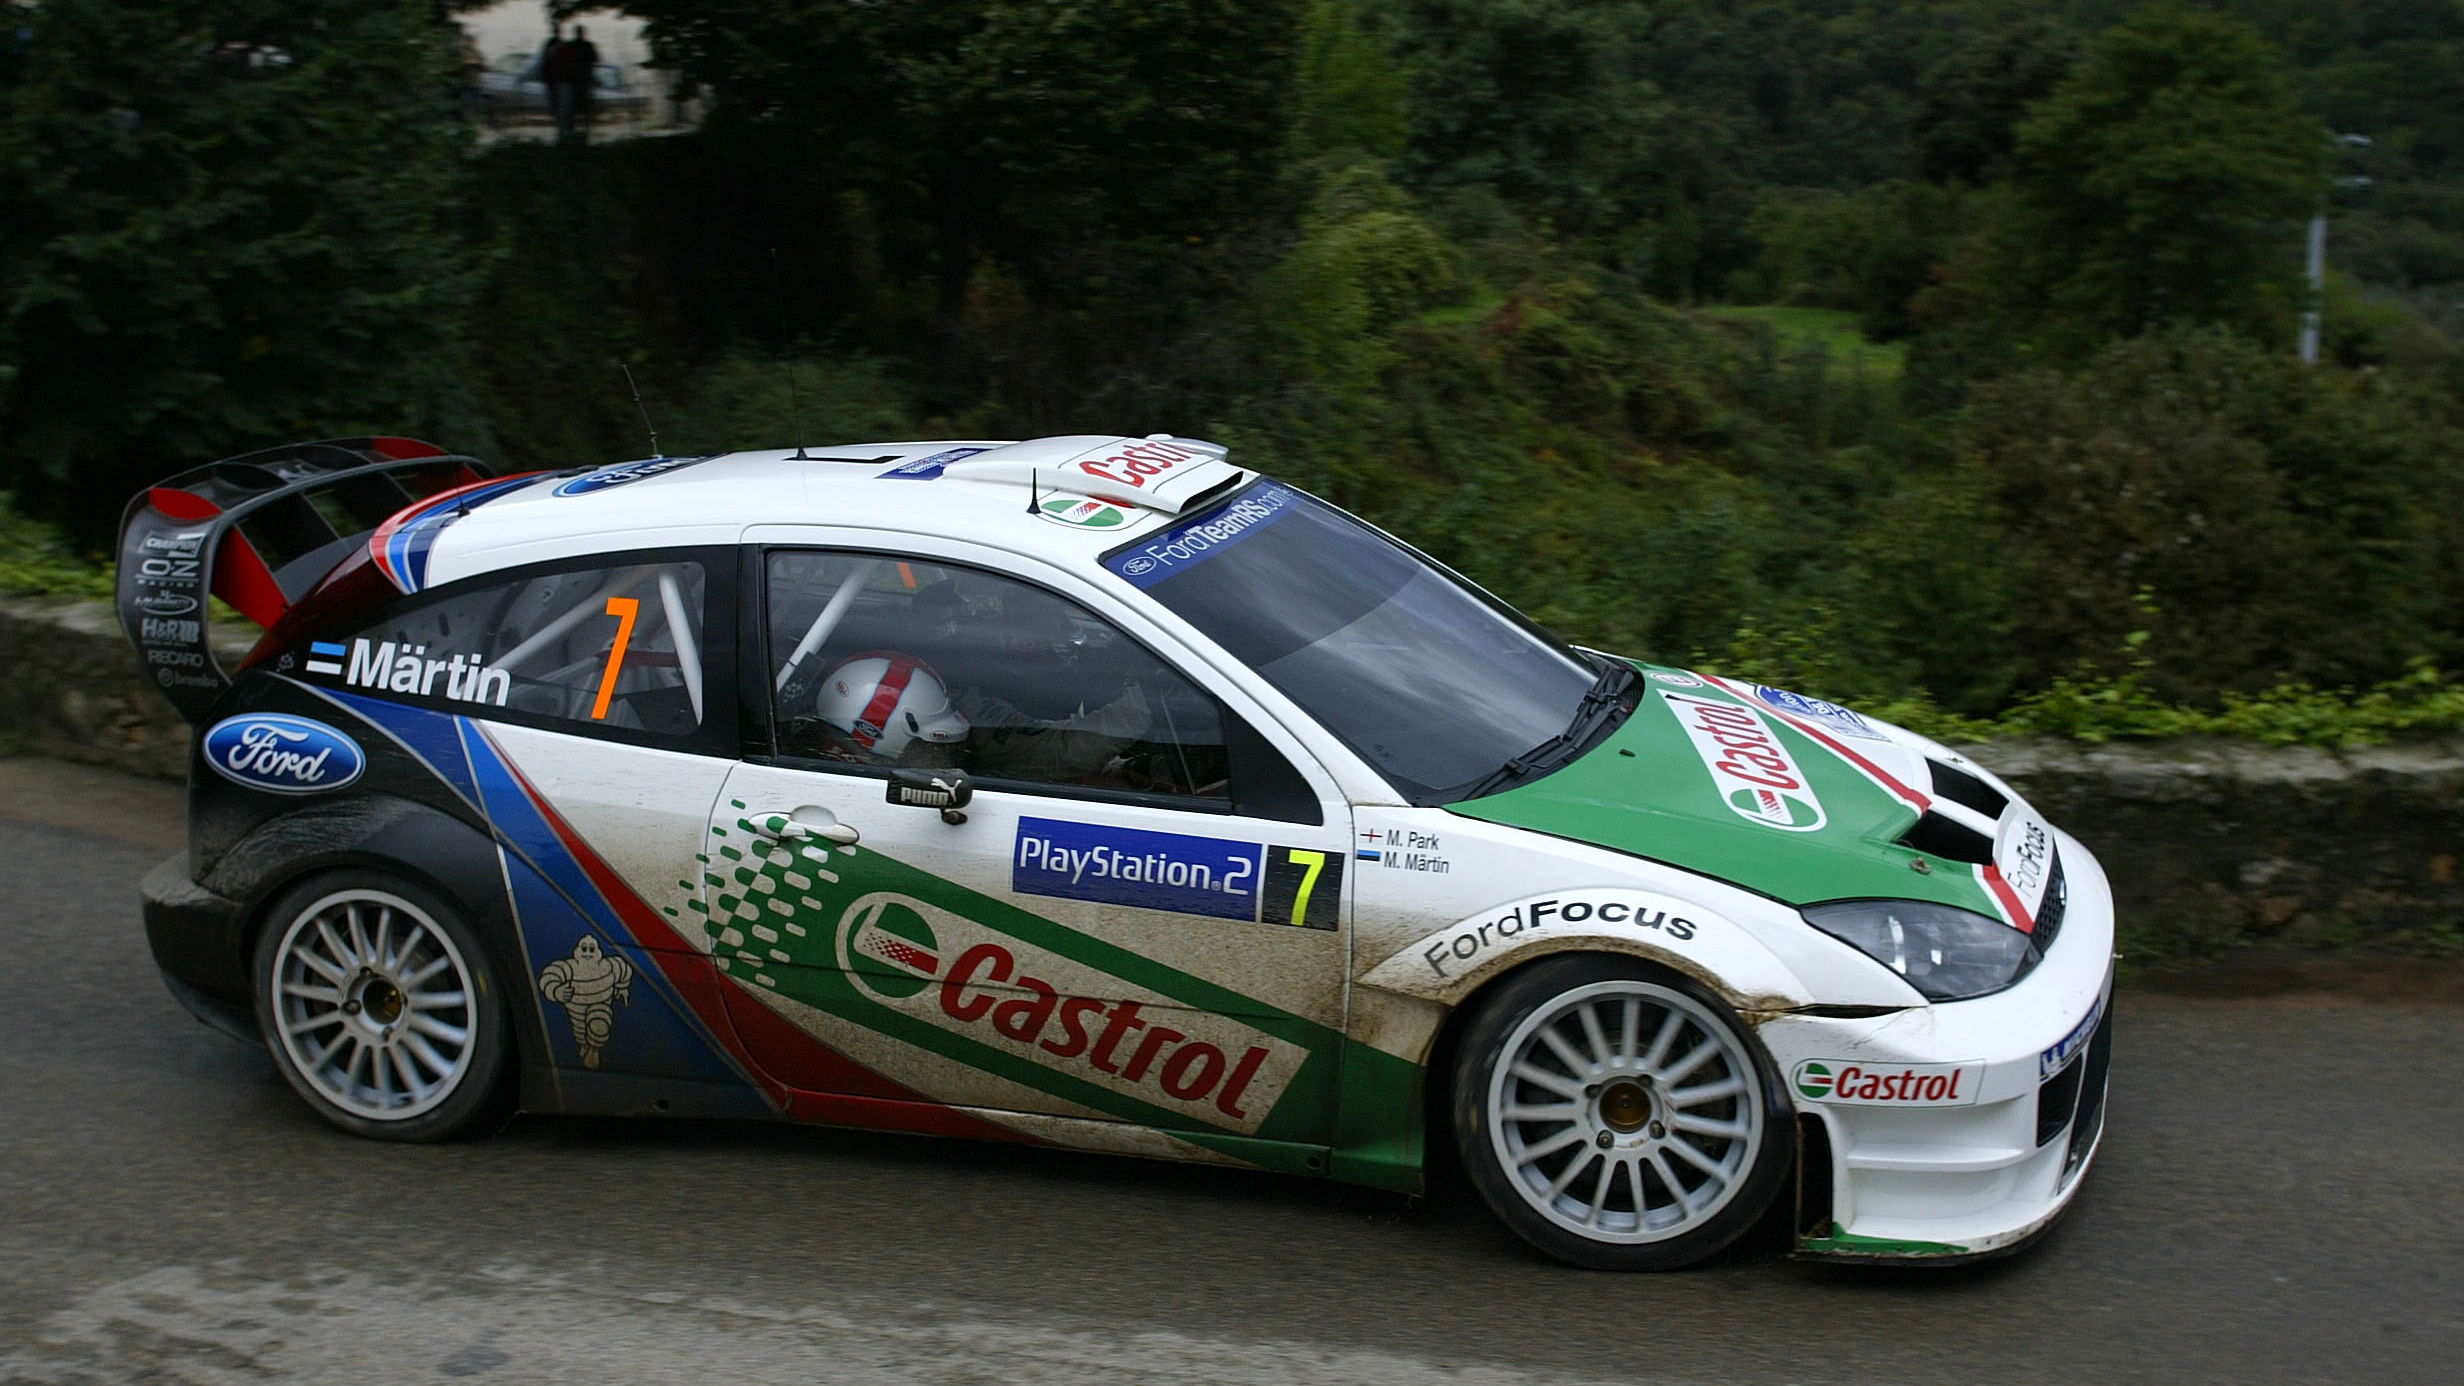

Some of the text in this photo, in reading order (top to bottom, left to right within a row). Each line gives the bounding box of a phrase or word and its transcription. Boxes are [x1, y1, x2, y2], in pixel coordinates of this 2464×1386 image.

[1078, 442, 1199, 488] Castr
[1127, 561, 1153, 573] Ford
[346, 638, 512, 707] Märtin
[592, 597, 640, 720] 7
[228, 723, 332, 783] Ford
[1664, 693, 1800, 790] Castrol
[1384, 851, 1449, 873] M. Märtin
[1386, 829, 1440, 850] M. Park
[1288, 849, 1326, 926] 7
[1424, 899, 1698, 979] FordFocus
[939, 943, 1271, 1120] Castrol
[1836, 1067, 1961, 1101] Castrol
